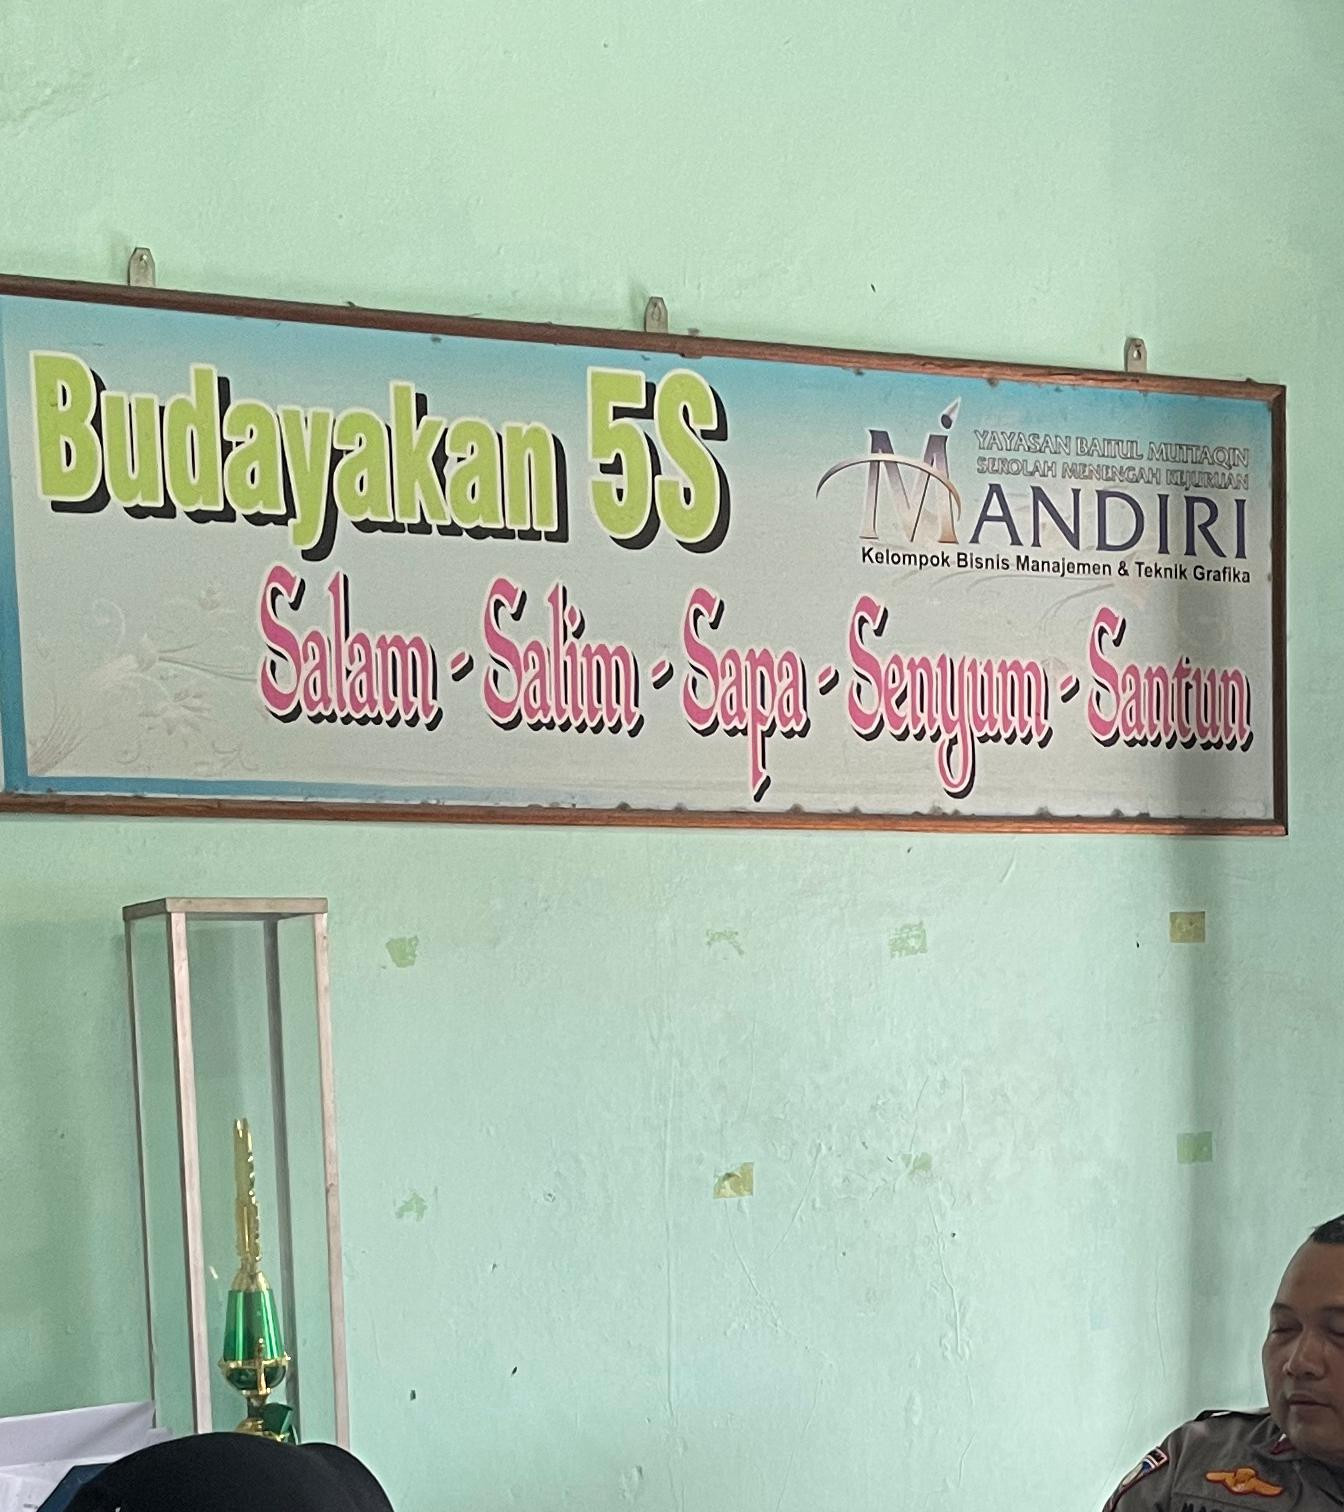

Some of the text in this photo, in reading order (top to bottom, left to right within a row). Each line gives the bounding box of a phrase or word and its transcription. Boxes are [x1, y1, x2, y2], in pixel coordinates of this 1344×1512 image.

[30, 349, 730, 558] Budayakan 5S
[974, 429, 1249, 470] YAYASAN BAITUL MUTTAQIN
[977, 456, 1249, 491] SEKOLAH MENENGAH KEJURUAN
[859, 429, 1248, 560] MANDIRI
[862, 546, 1251, 584] Kelompok Bisnis Manajemen & Teknik Grafika
[257, 563, 442, 732] Salam
[482, 575, 643, 736] Salim
[681, 587, 810, 802] Sapa
[847, 594, 1053, 798] Senyum
[1088, 607, 1253, 750] Santun
